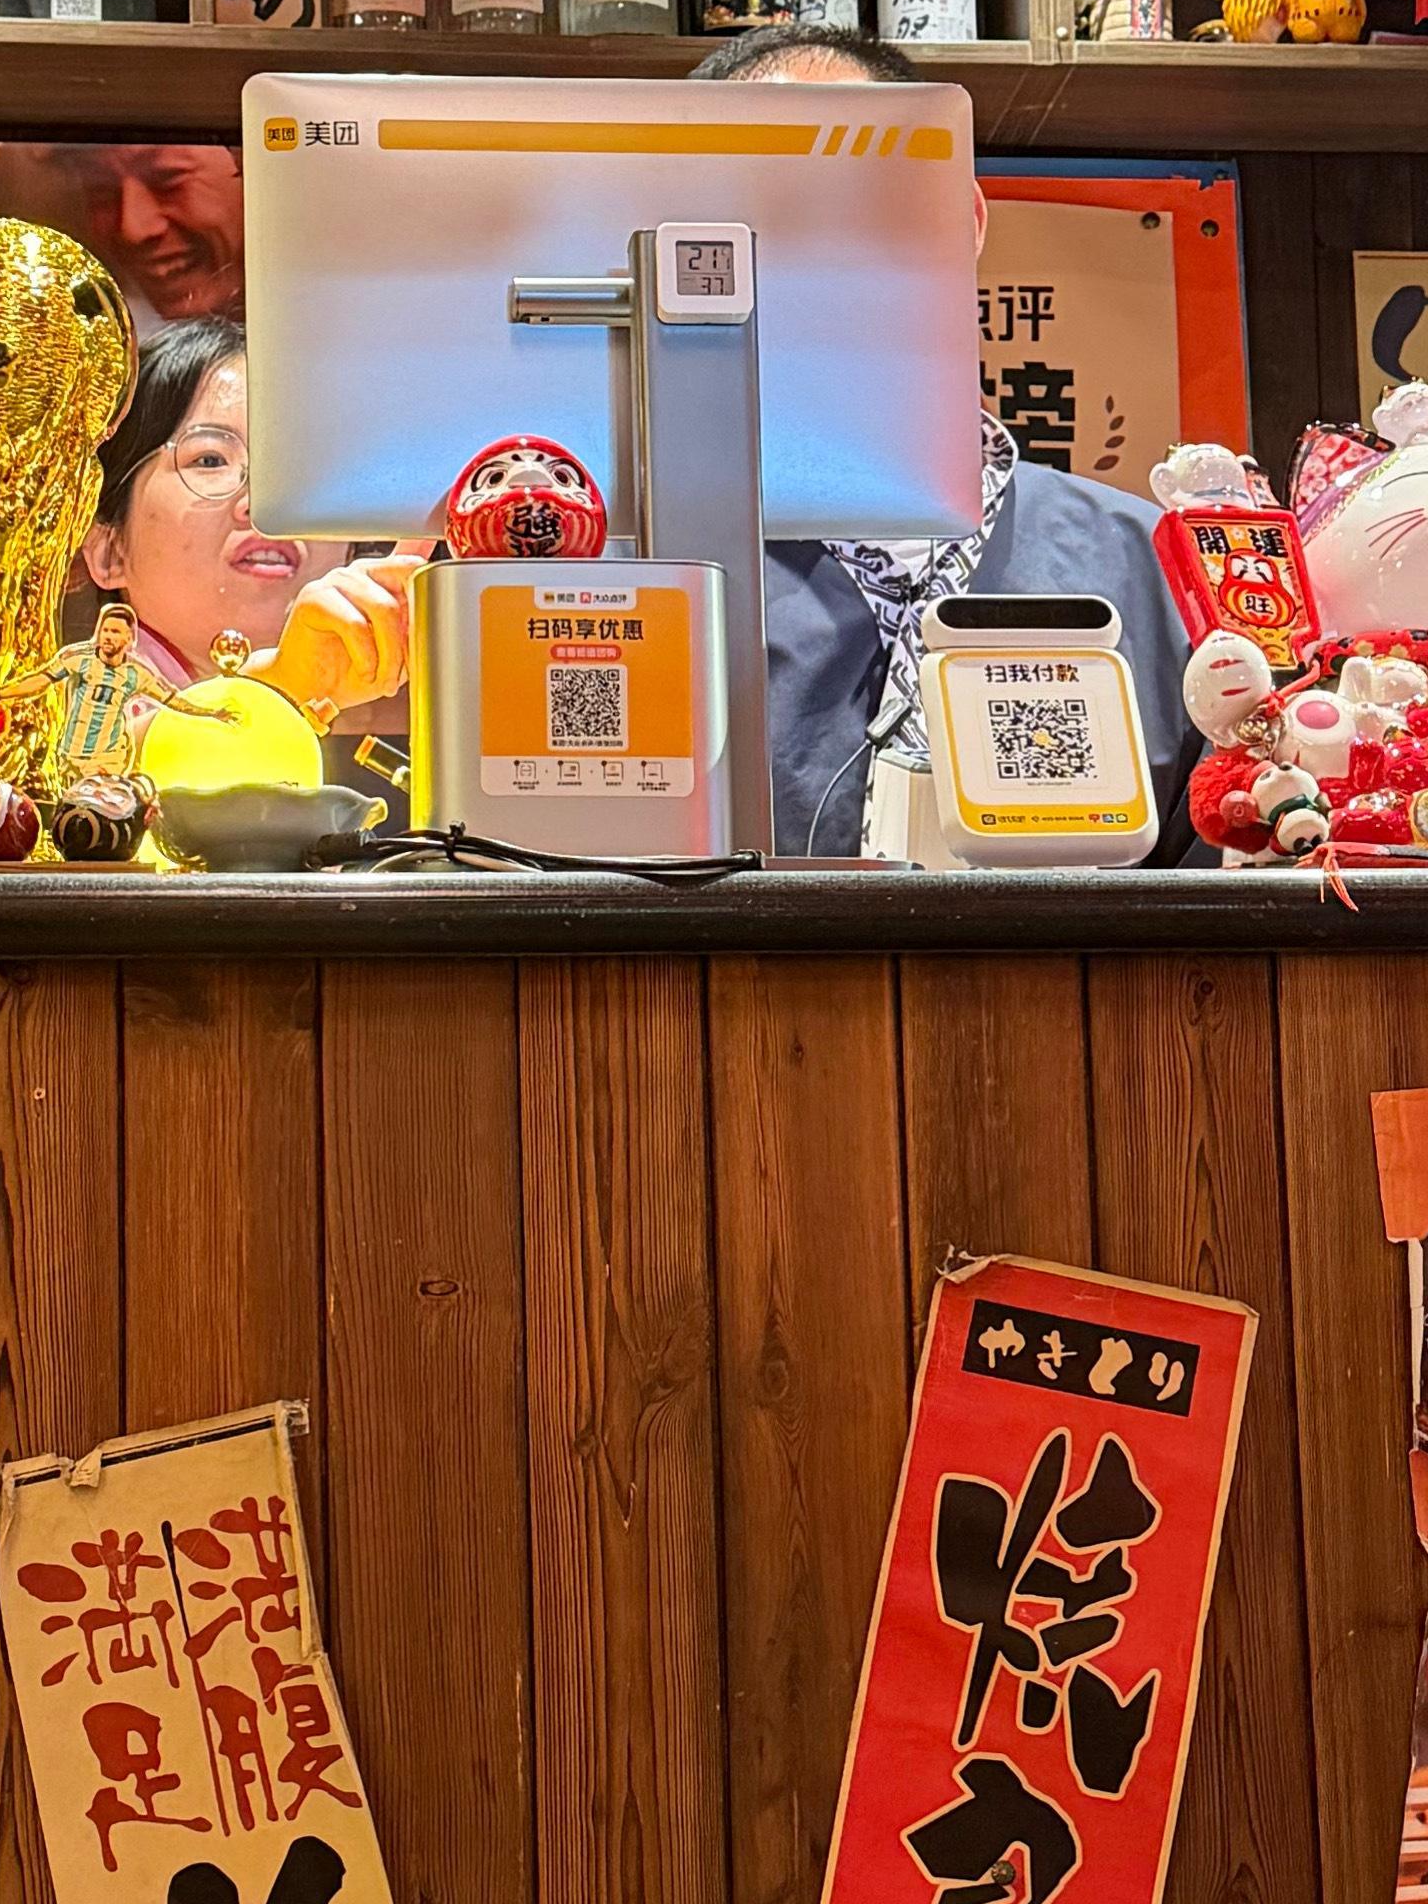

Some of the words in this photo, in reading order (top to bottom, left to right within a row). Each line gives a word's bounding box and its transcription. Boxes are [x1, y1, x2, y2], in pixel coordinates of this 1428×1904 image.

[304, 120, 360, 147] 美团
[1191, 525, 1289, 559] 開運
[1243, 593, 1273, 614] 旺
[527, 618, 644, 641] 扫码享优惠
[983, 662, 1081, 686] 扫我付款
[976, 1318, 1188, 1404] やきとり
